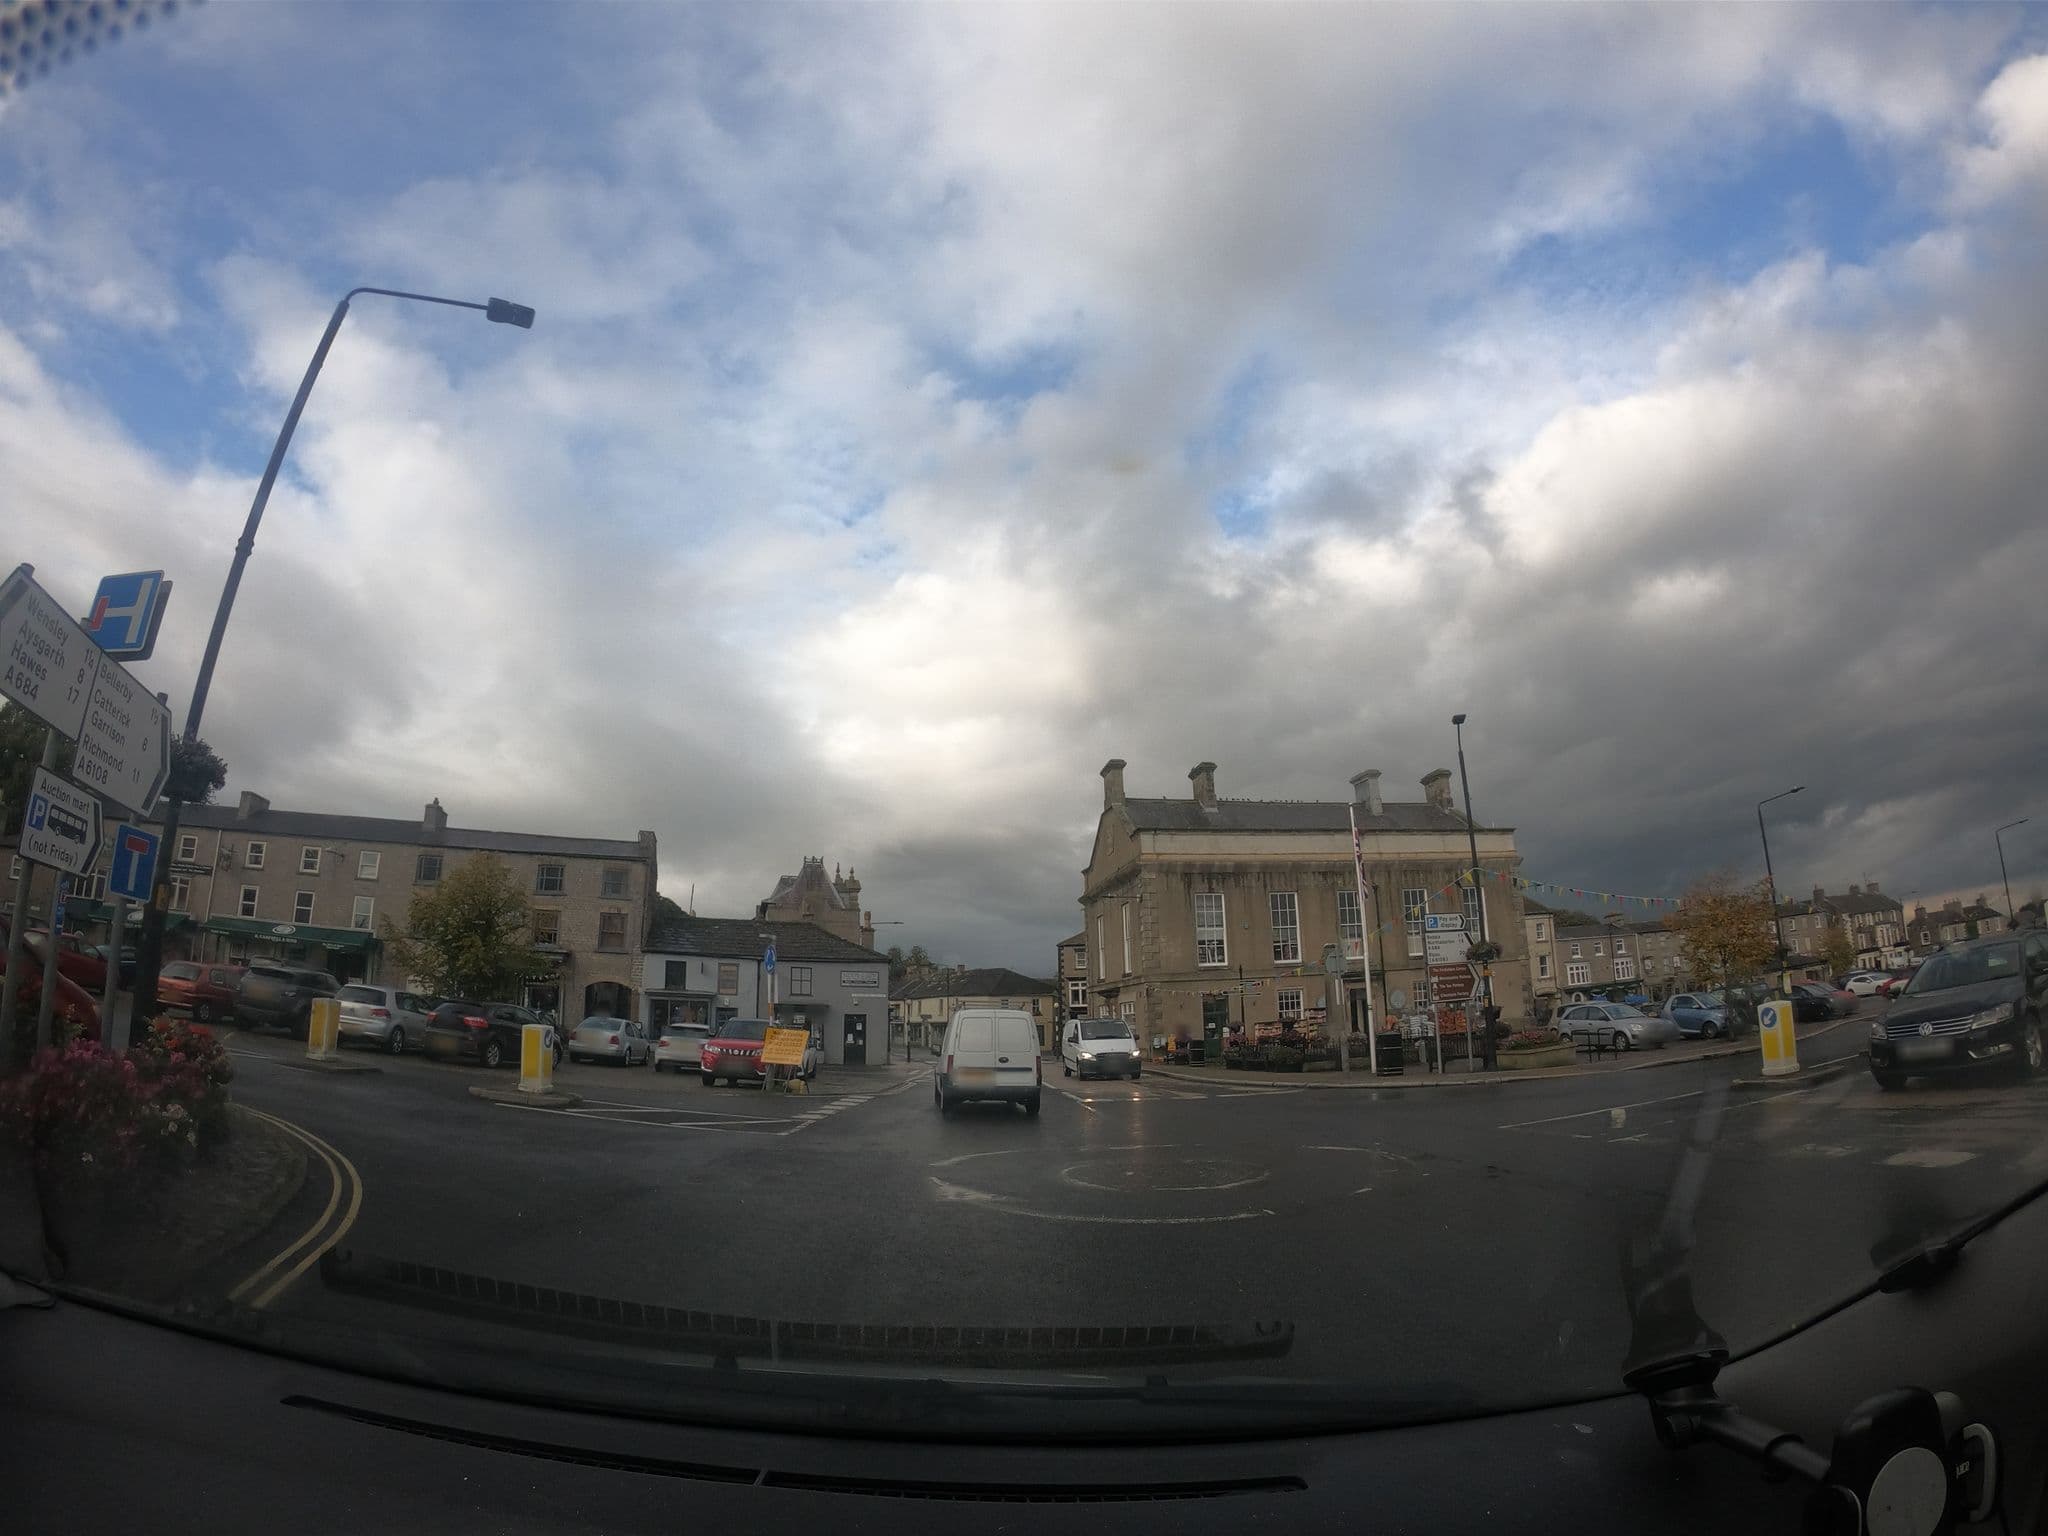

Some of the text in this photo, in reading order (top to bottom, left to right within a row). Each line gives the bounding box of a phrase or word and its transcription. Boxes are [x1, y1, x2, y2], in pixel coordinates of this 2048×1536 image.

[28, 594, 69, 646] Wensley
[11, 640, 79, 704] Hawes 17
[19, 621, 85, 684] Aysgarth 8
[4, 665, 39, 701] A684
[100, 663, 134, 703] Bellerby
[95, 689, 131, 728] Catterick
[91, 711, 148, 752] Garrison 8
[78, 755, 109, 785] A6108
[83, 734, 140, 784] Richmond 11
[40, 777, 90, 814] Auction mart
